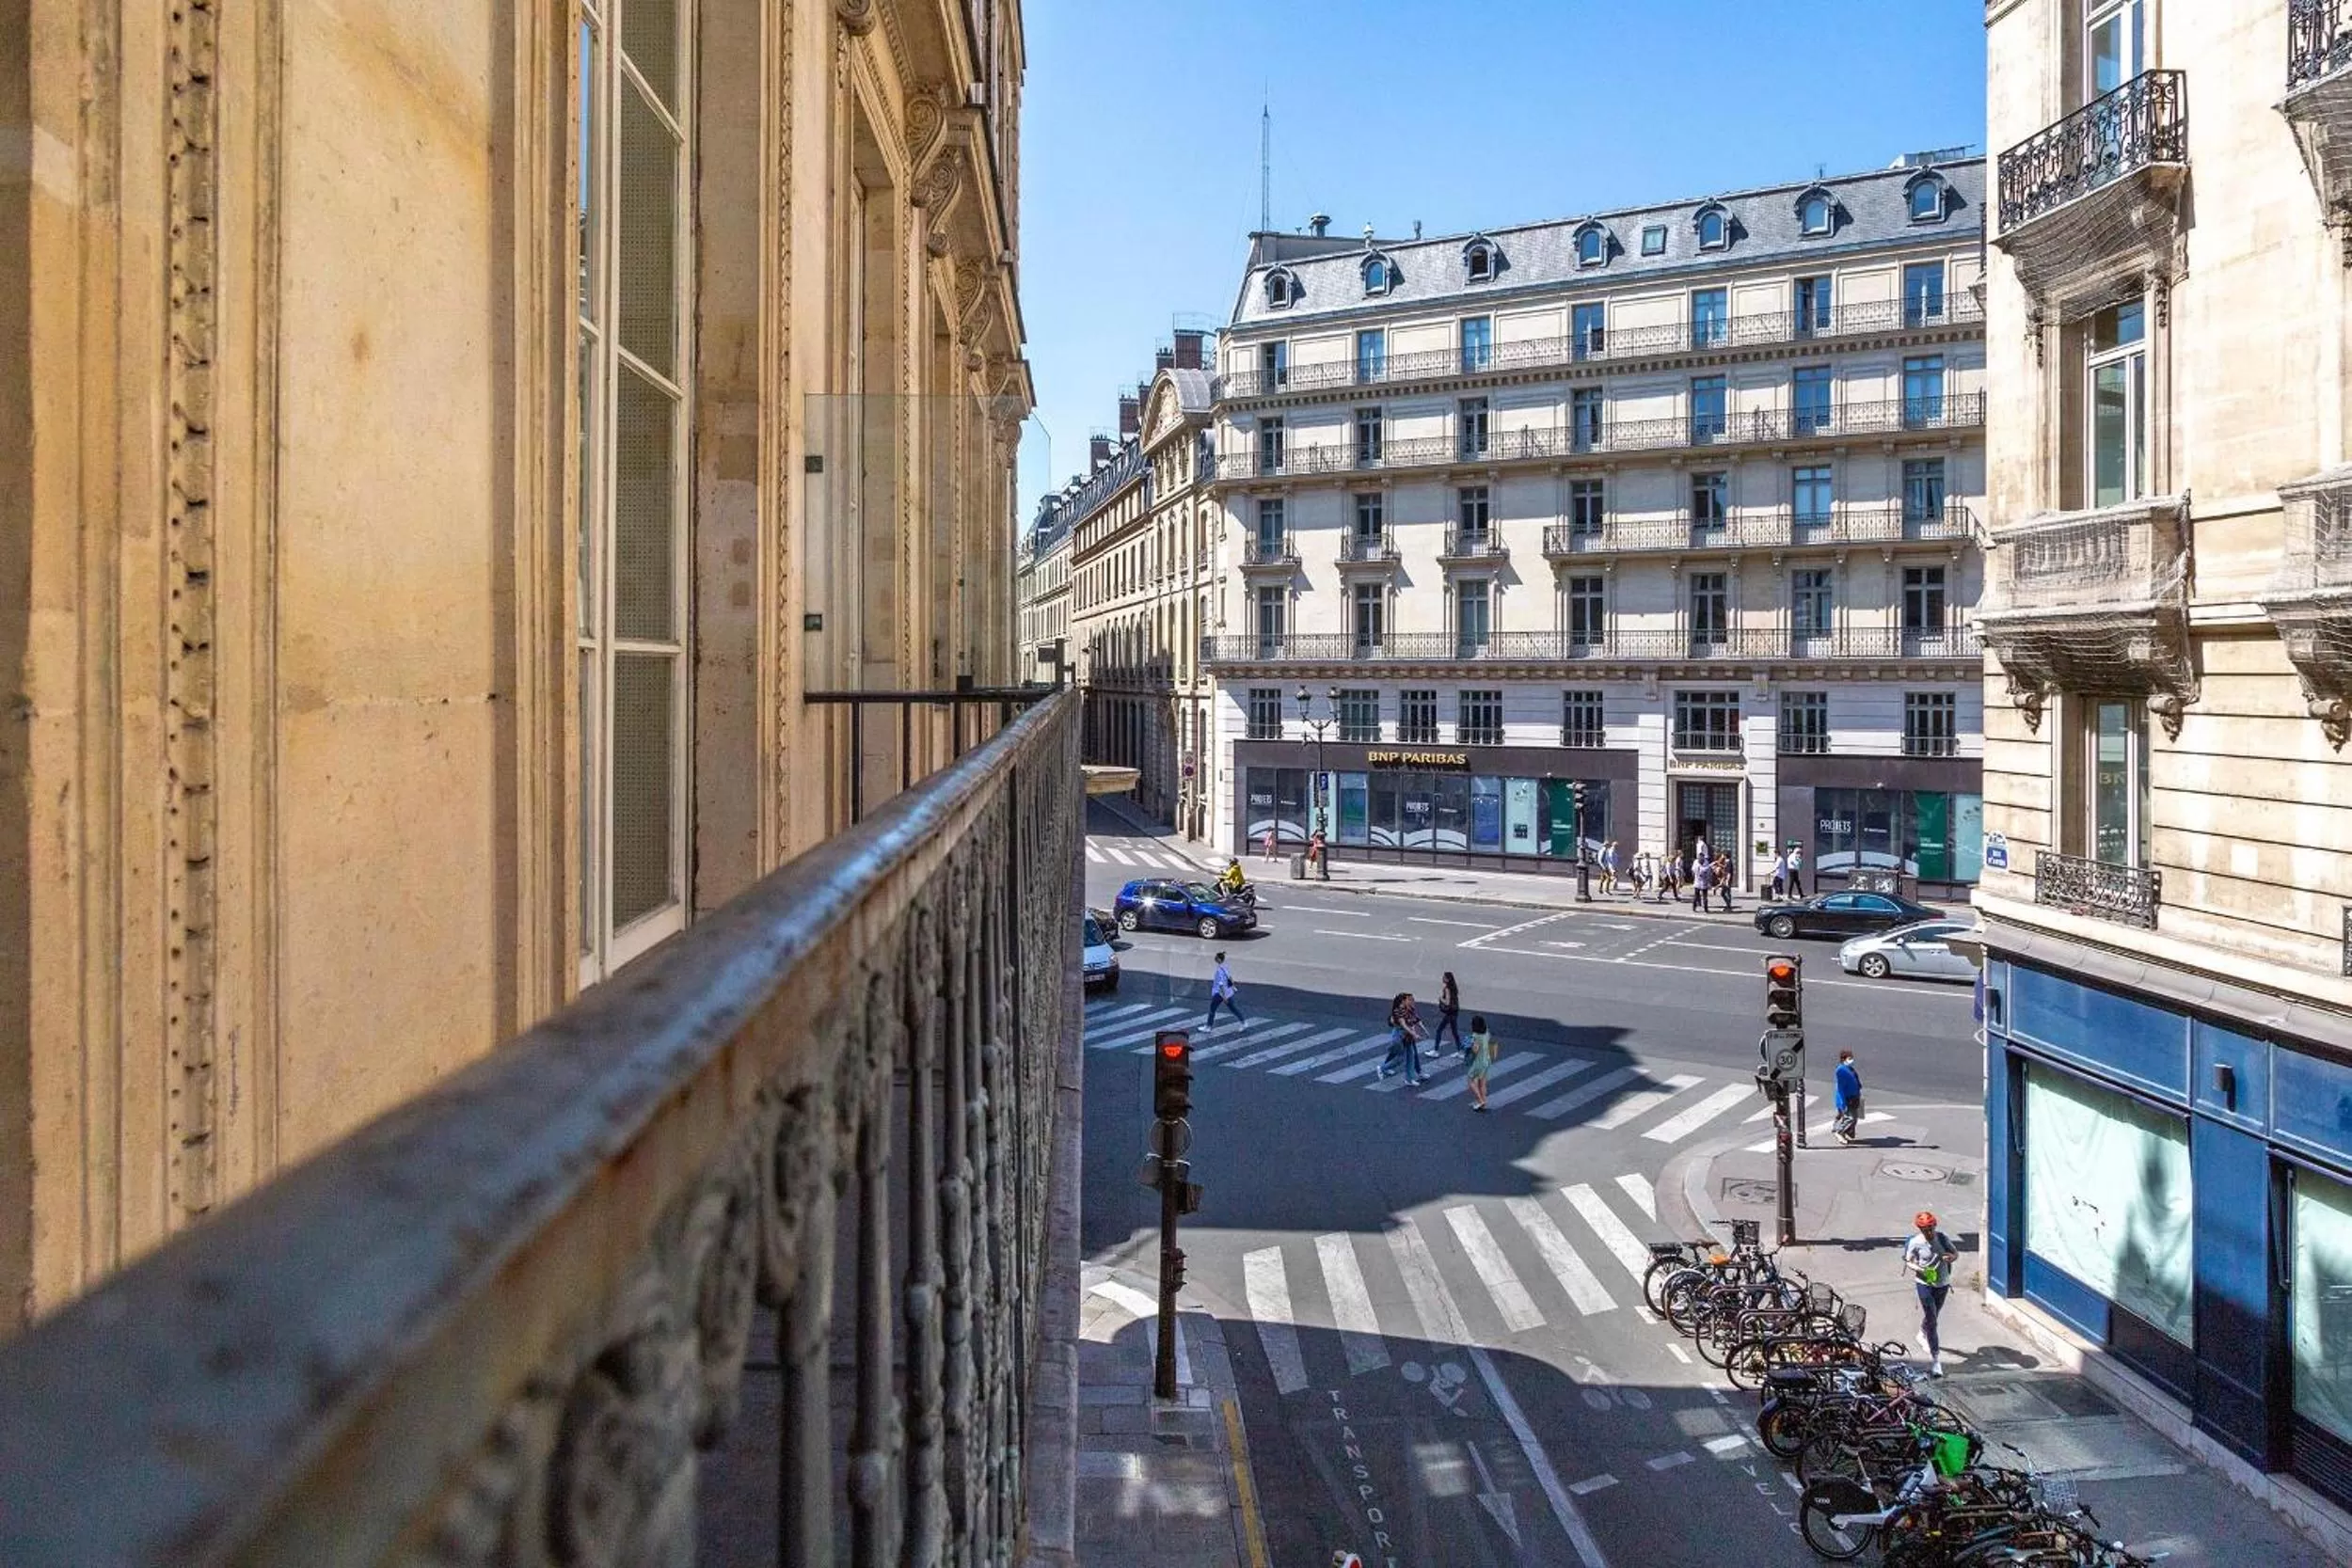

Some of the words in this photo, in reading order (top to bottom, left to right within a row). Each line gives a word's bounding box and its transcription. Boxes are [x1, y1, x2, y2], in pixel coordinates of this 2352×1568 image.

[1368, 752, 1398, 762] BNP
[1402, 752, 1467, 764] PARIBAS
[1780, 1054, 1793, 1066] 30
